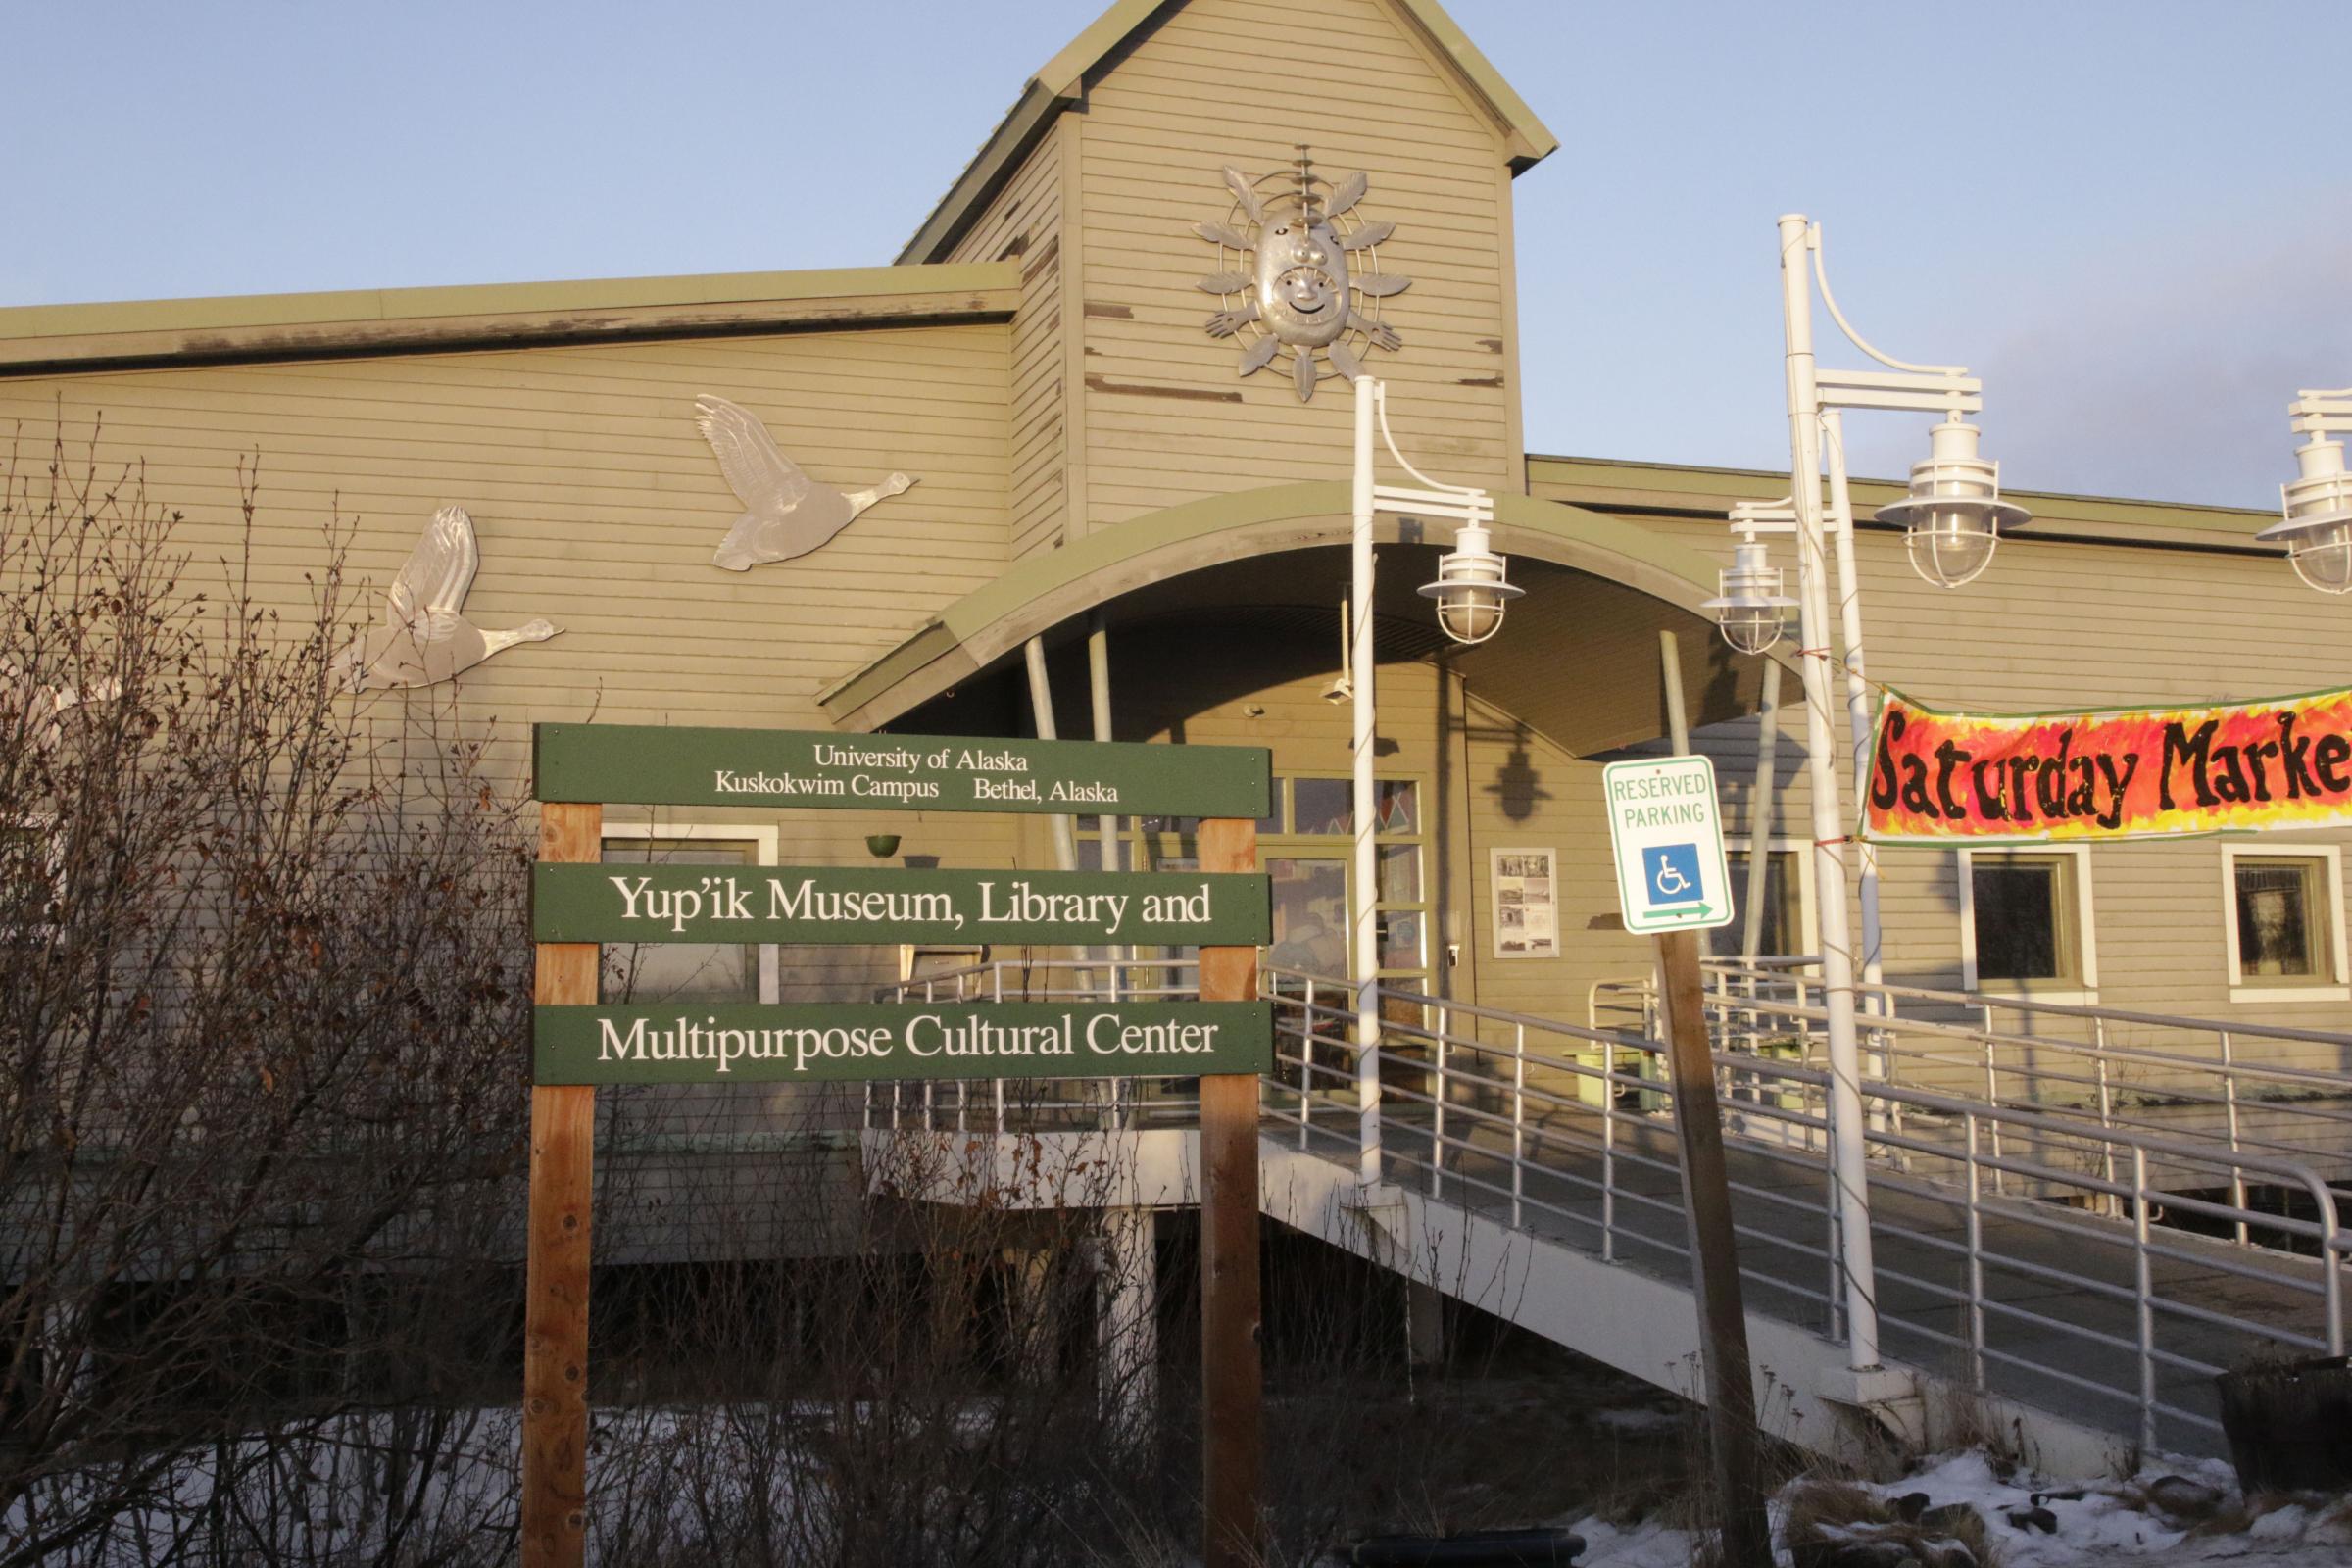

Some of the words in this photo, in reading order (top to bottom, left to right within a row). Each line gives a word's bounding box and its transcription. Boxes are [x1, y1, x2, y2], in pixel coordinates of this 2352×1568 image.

[811, 743, 922, 774] University
[926, 746, 951, 770] of
[955, 748, 1030, 772] Alaska
[1872, 710, 2138, 830] Saturday
[2159, 710, 2352, 811] Marke
[712, 768, 848, 797] Kuskokwim
[850, 772, 941, 804] Campus
[972, 776, 1044, 805] Bethel,
[1048, 779, 1120, 804] Alaska
[1613, 773, 1706, 801] RESERVED
[1624, 802, 1705, 829] PARKING
[608, 875, 755, 933] Yup'ik
[764, 877, 965, 931] Museum,
[976, 880, 1130, 935] Library
[1141, 882, 1214, 924] and
[596, 1014, 895, 1073] Multipurpose
[905, 1012, 1076, 1057] Cultural
[1085, 1012, 1221, 1055] Center
